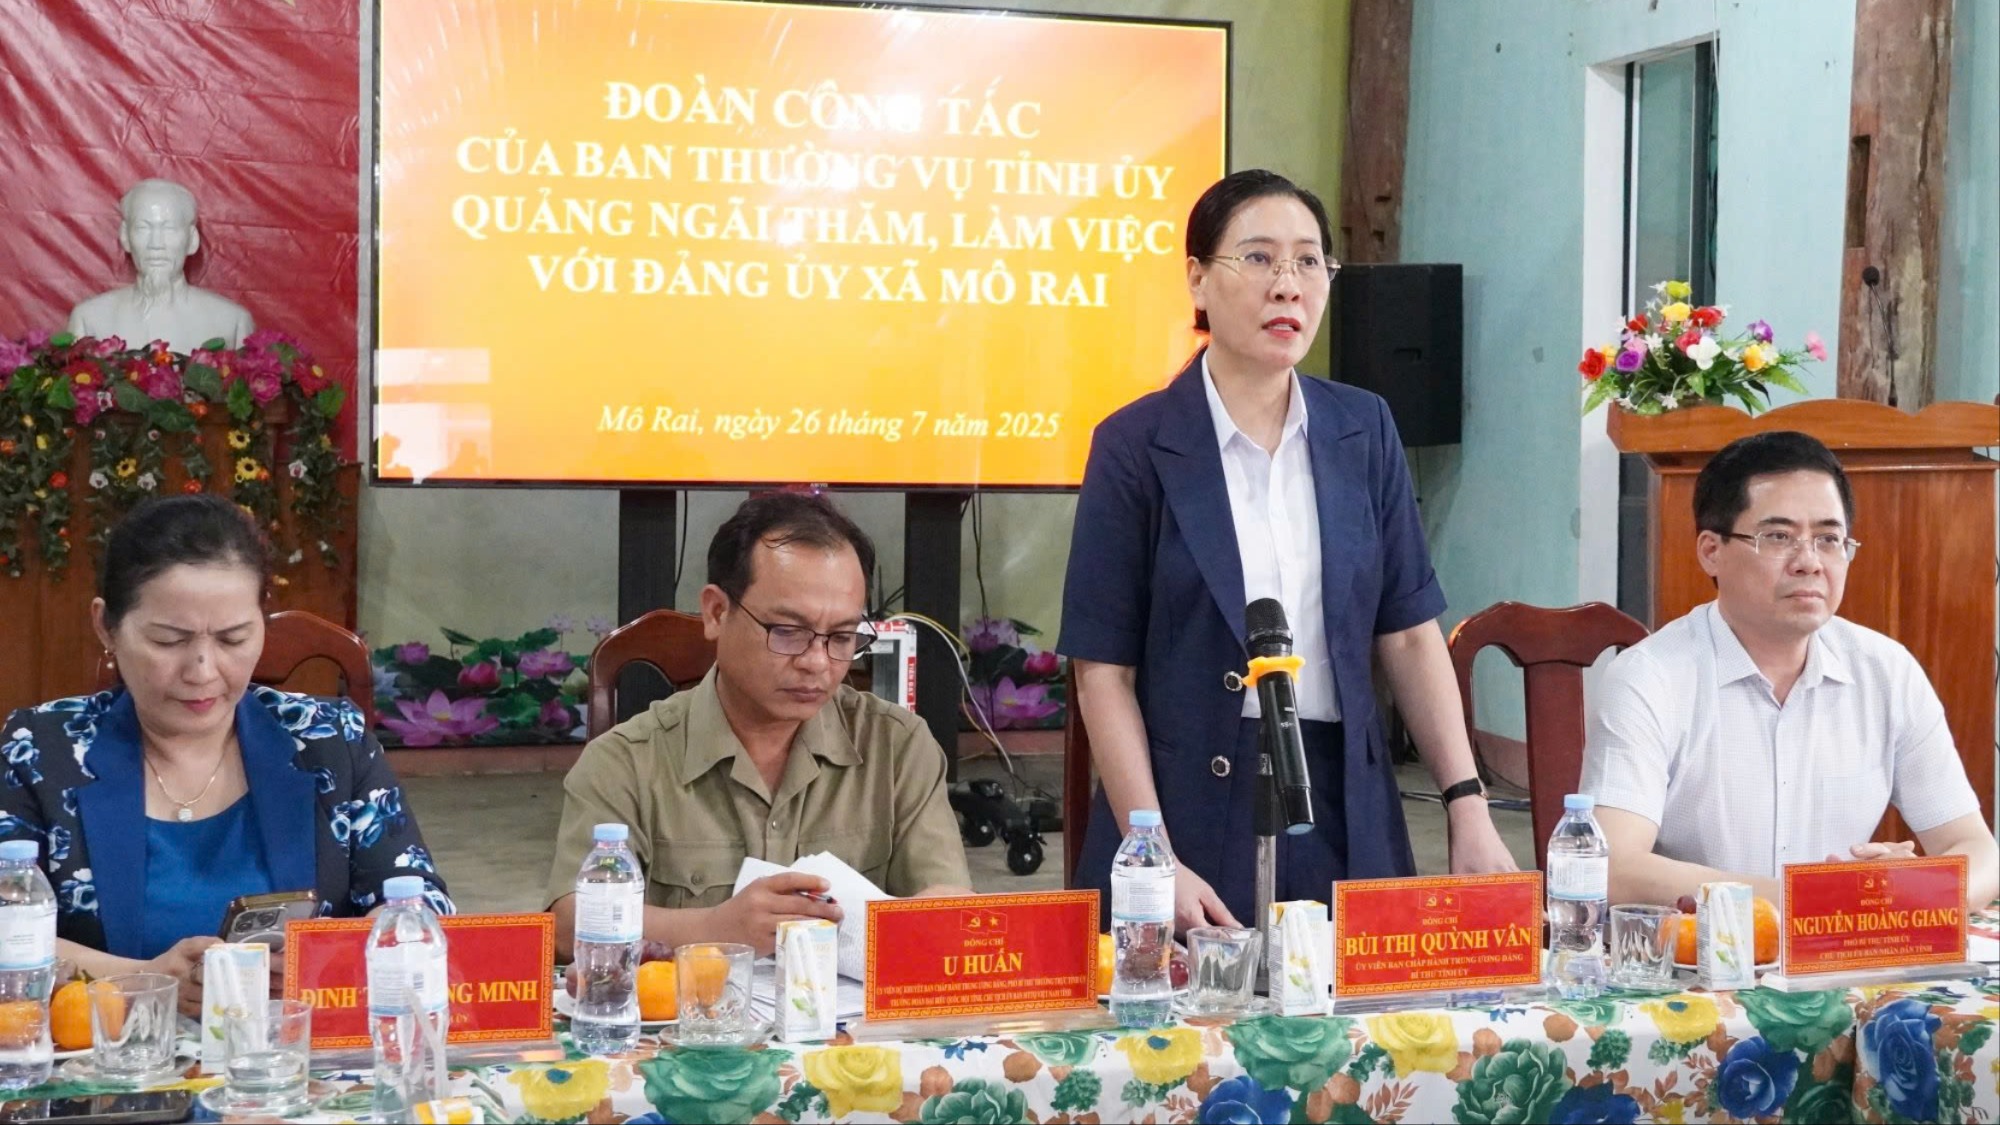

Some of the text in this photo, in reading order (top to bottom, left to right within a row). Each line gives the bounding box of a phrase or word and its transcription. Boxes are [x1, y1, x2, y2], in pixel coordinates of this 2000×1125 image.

[604, 74, 758, 125] ĐOÀN
[773, 79, 922, 133] CÔNG
[456, 127, 1174, 201] CỦA BAN THƯỜNG VỤ TỈNH ỦY
[452, 187, 1175, 264] QUẢNG NGÃI THĂM, LÀM VIỆC
[528, 246, 1109, 308] VỚI ĐẢNG ỦY XÃ MÔ RAI
[597, 405, 1061, 443] Mô Rai, ngày 26 tháng 7 năm 2025
[1345, 922, 1532, 958] BÙI THỊ QUỲNH VÂN
[1793, 907, 1958, 936] NGUYỄN HOÀNG GIANG
[943, 948, 1023, 976] U HUẤN
[1368, 961, 1385, 970] VIÊN
[1450, 957, 1476, 965] TRUNG
[300, 987, 357, 1009] ĐINH
[478, 980, 538, 1003] MINH
